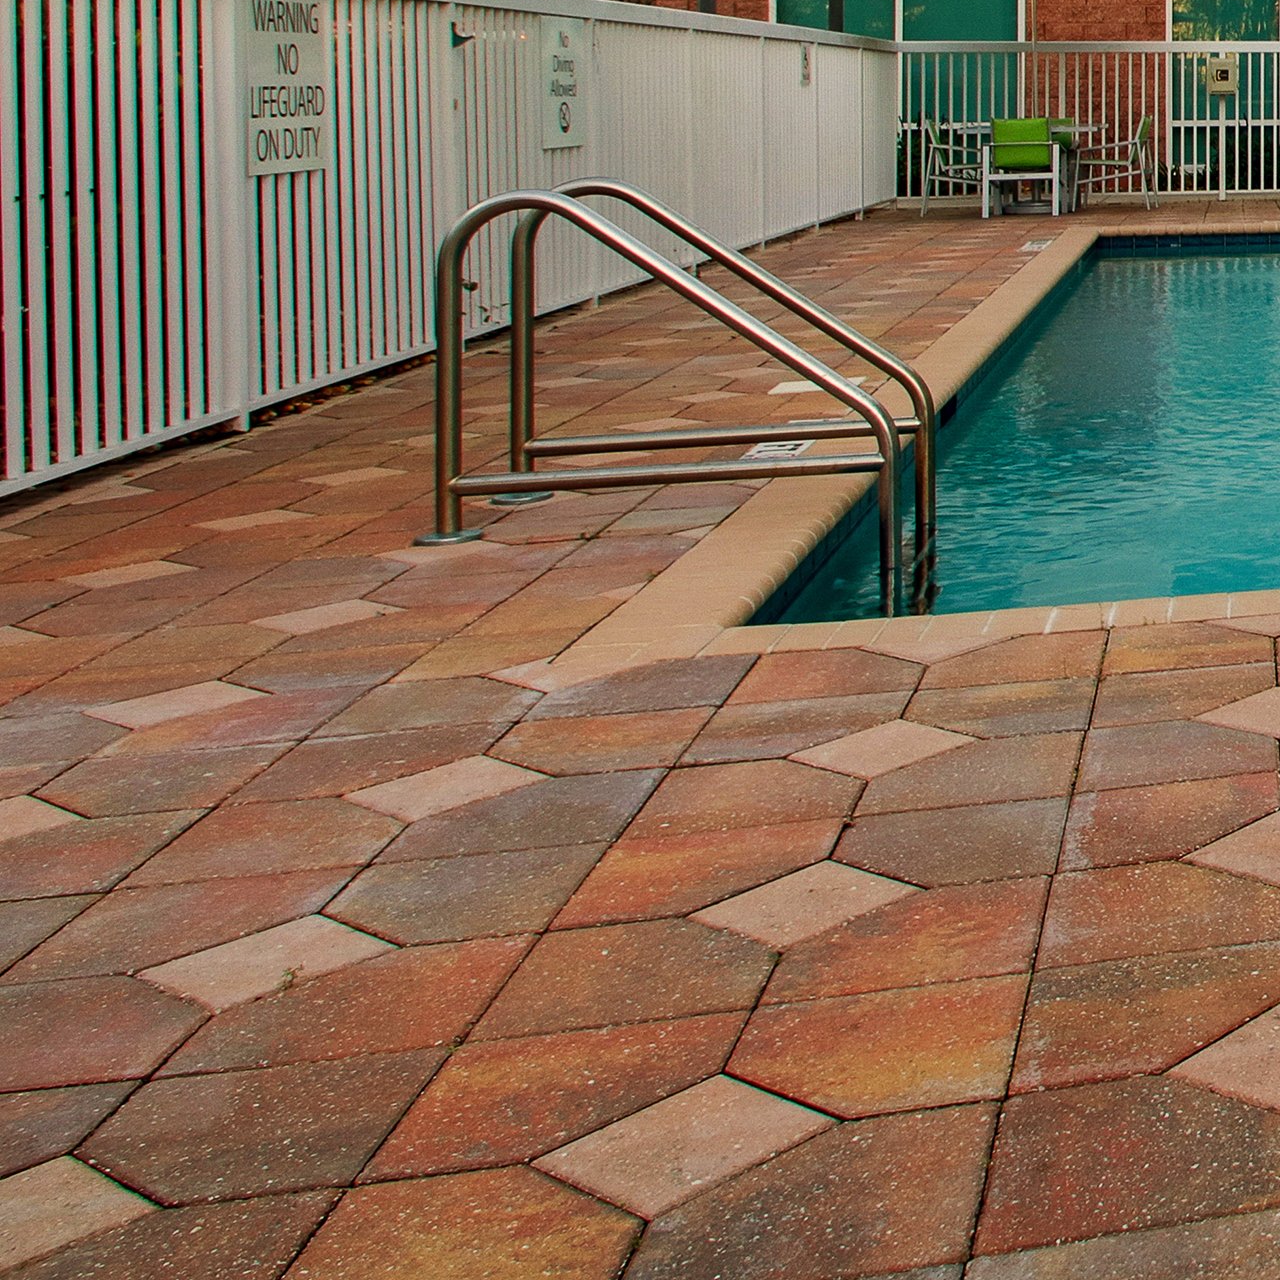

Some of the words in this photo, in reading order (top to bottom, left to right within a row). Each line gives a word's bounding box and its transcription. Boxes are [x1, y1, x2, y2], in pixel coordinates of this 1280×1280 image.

[559, 31, 569, 48] No
[277, 43, 299, 75] NO
[553, 55, 575, 77] Diving
[251, 86, 325, 118] LIFEGUARD
[550, 80, 577, 97] Allowed
[256, 129, 280, 161] ON
[284, 126, 320, 160] DUTY
